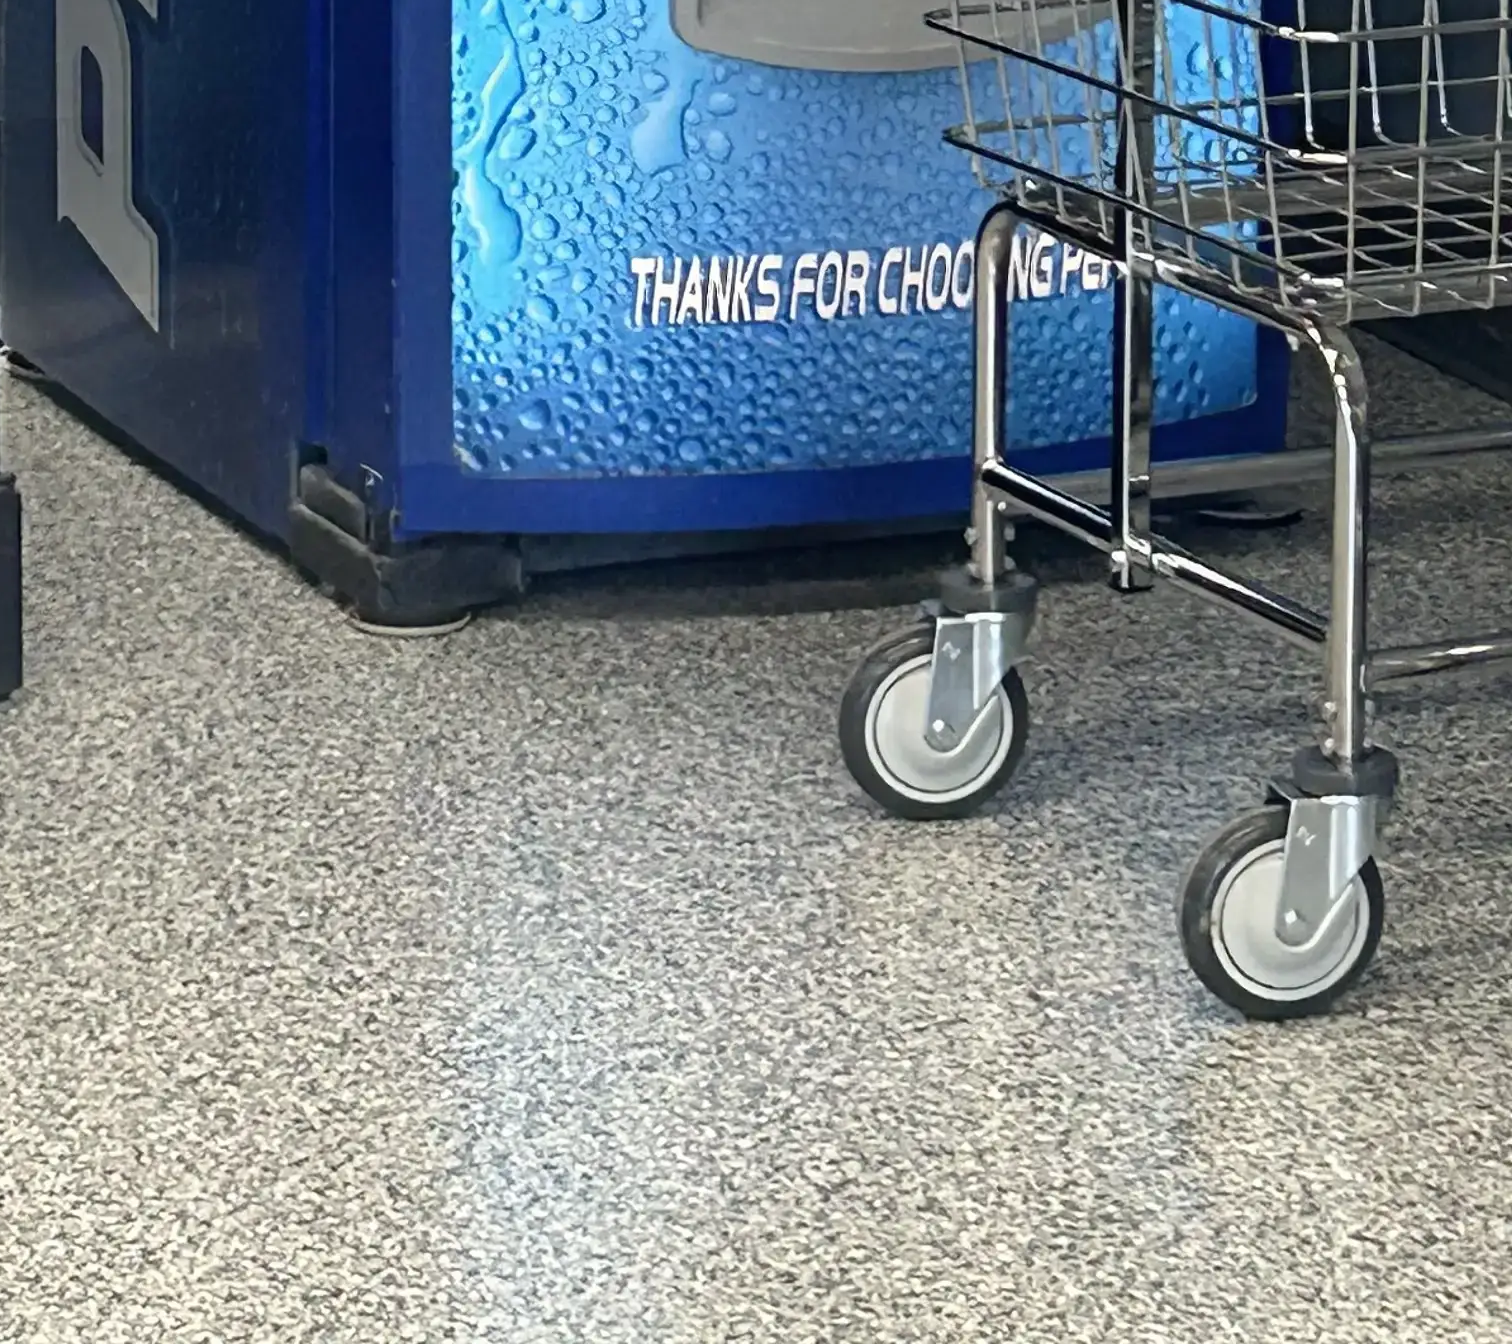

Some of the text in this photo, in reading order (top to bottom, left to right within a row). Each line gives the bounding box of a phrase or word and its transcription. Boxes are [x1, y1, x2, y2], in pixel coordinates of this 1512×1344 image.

[630, 253, 784, 327] THANKS
[789, 248, 872, 322] FOR
[878, 229, 1058, 315] CHOONG
